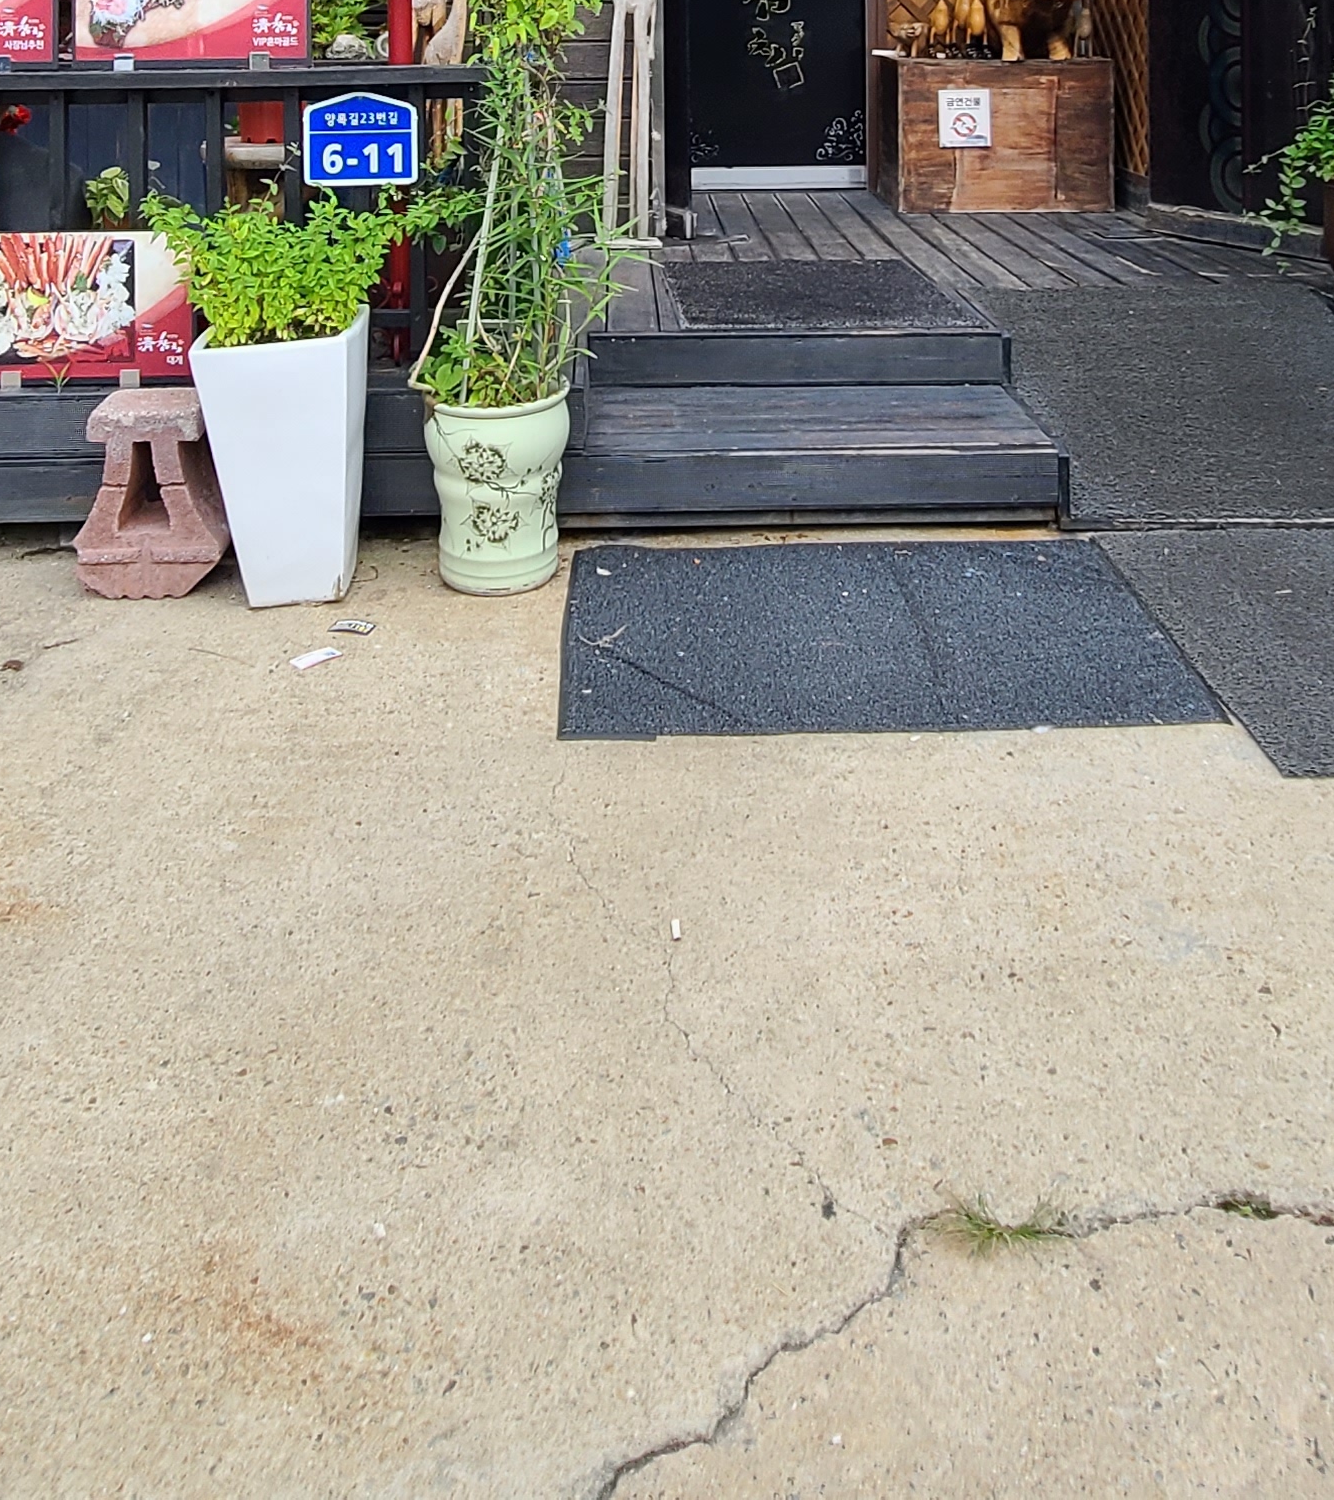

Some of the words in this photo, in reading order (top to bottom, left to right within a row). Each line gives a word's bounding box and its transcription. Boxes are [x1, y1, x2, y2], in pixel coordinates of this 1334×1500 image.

[3, 40, 45, 50] 사장님추천
[946, 97, 981, 107] 금연건물
[322, 143, 404, 175] 6-11
[166, 355, 184, 365] 대게
